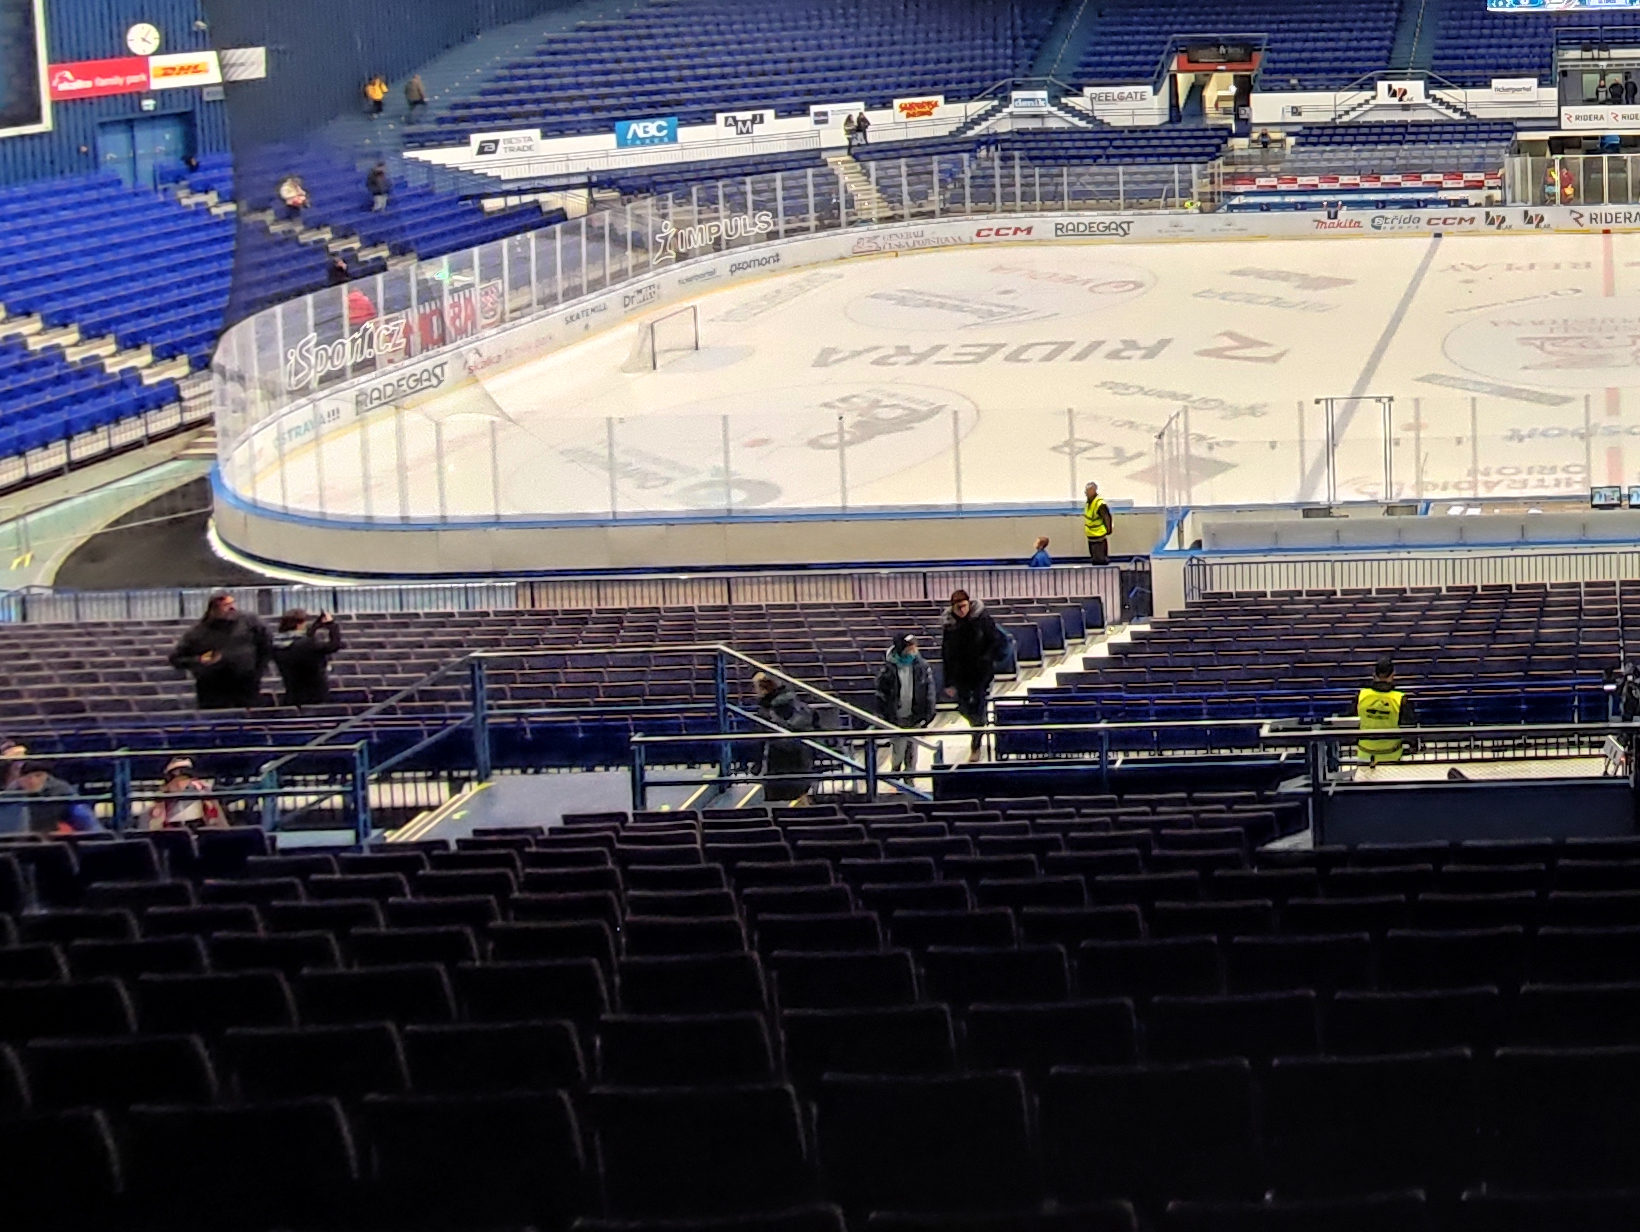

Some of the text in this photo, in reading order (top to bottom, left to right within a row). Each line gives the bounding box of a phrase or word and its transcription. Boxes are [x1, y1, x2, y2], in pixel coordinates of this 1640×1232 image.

[161, 64, 205, 77] DHL
[1090, 90, 1148, 102] REELGATE
[1574, 114, 1605, 123] RIDERA
[626, 121, 669, 139] ABC
[502, 144, 536, 154] TRADE
[1313, 219, 1364, 230] makita
[1426, 217, 1475, 226] CCM
[677, 210, 774, 253] IMPULS
[975, 226, 1034, 238] CCM
[1054, 220, 1135, 237] RADEGAST
[811, 337, 1174, 368] RIDERA
[355, 361, 449, 415] RADEGAST
